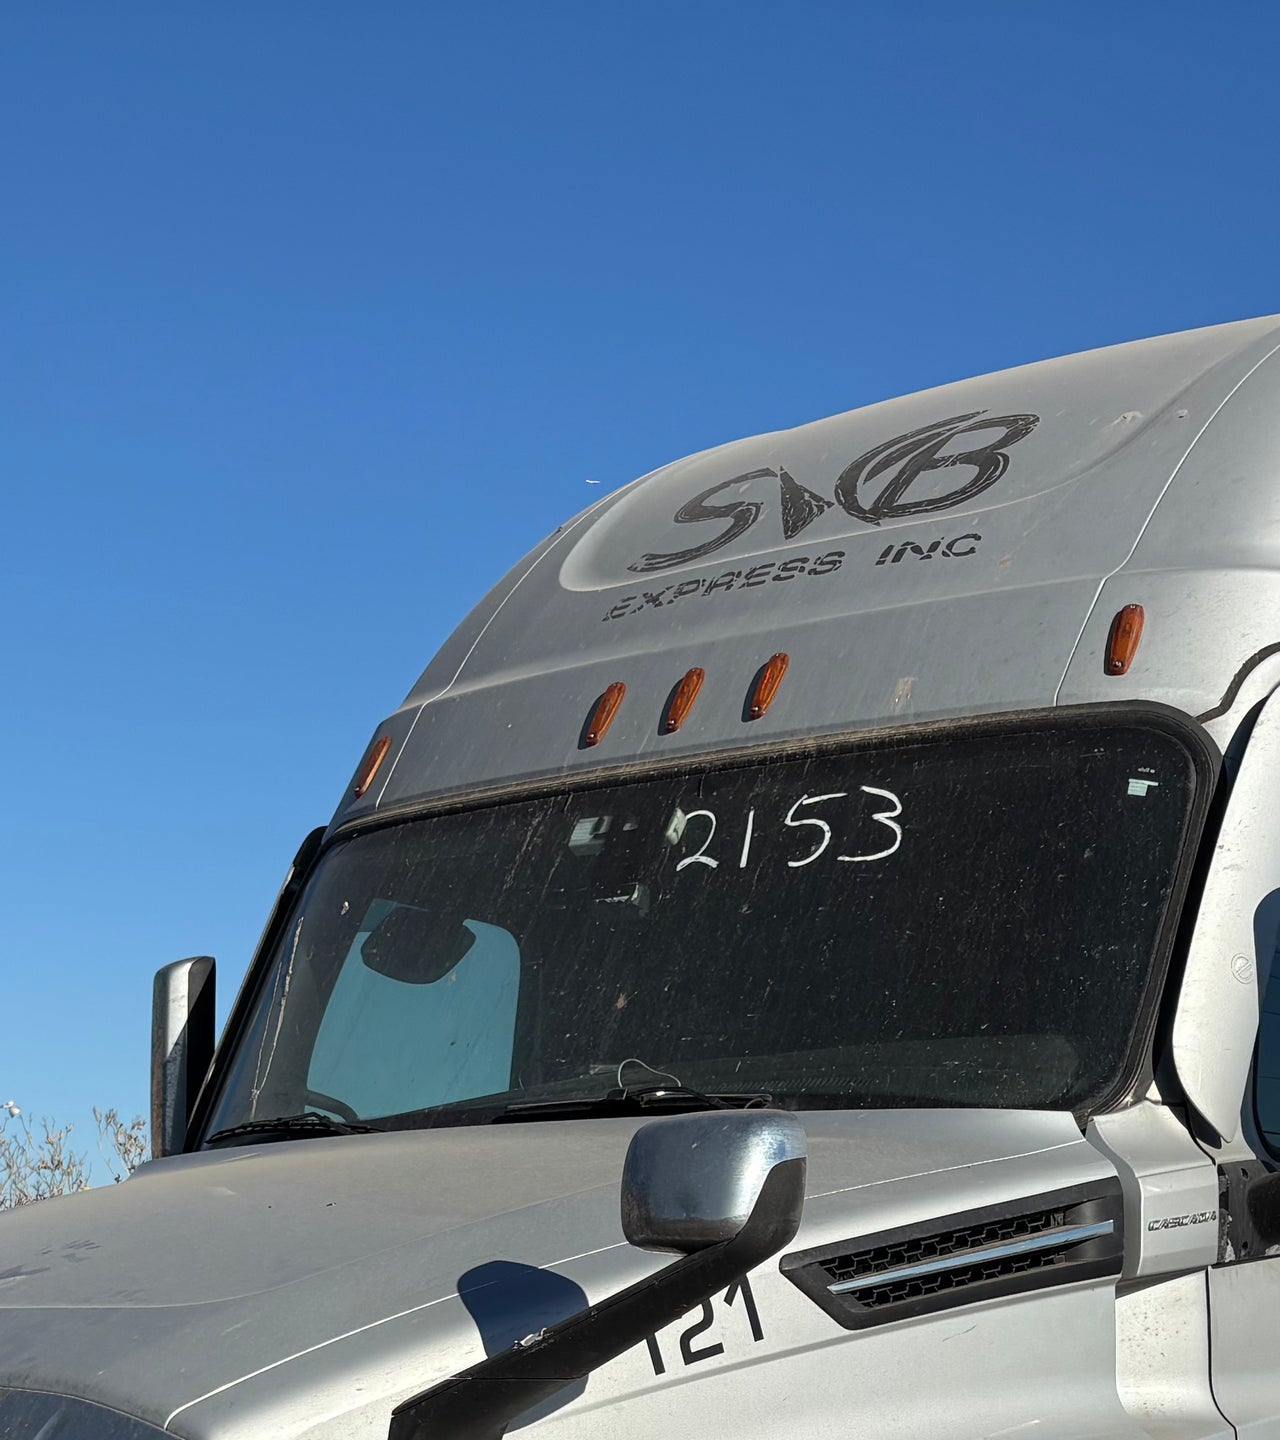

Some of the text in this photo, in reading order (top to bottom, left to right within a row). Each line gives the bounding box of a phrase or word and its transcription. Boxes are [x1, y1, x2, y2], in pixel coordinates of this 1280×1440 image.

[602, 532, 982, 622] EXPRESS INC
[676, 786, 902, 871] 2153
